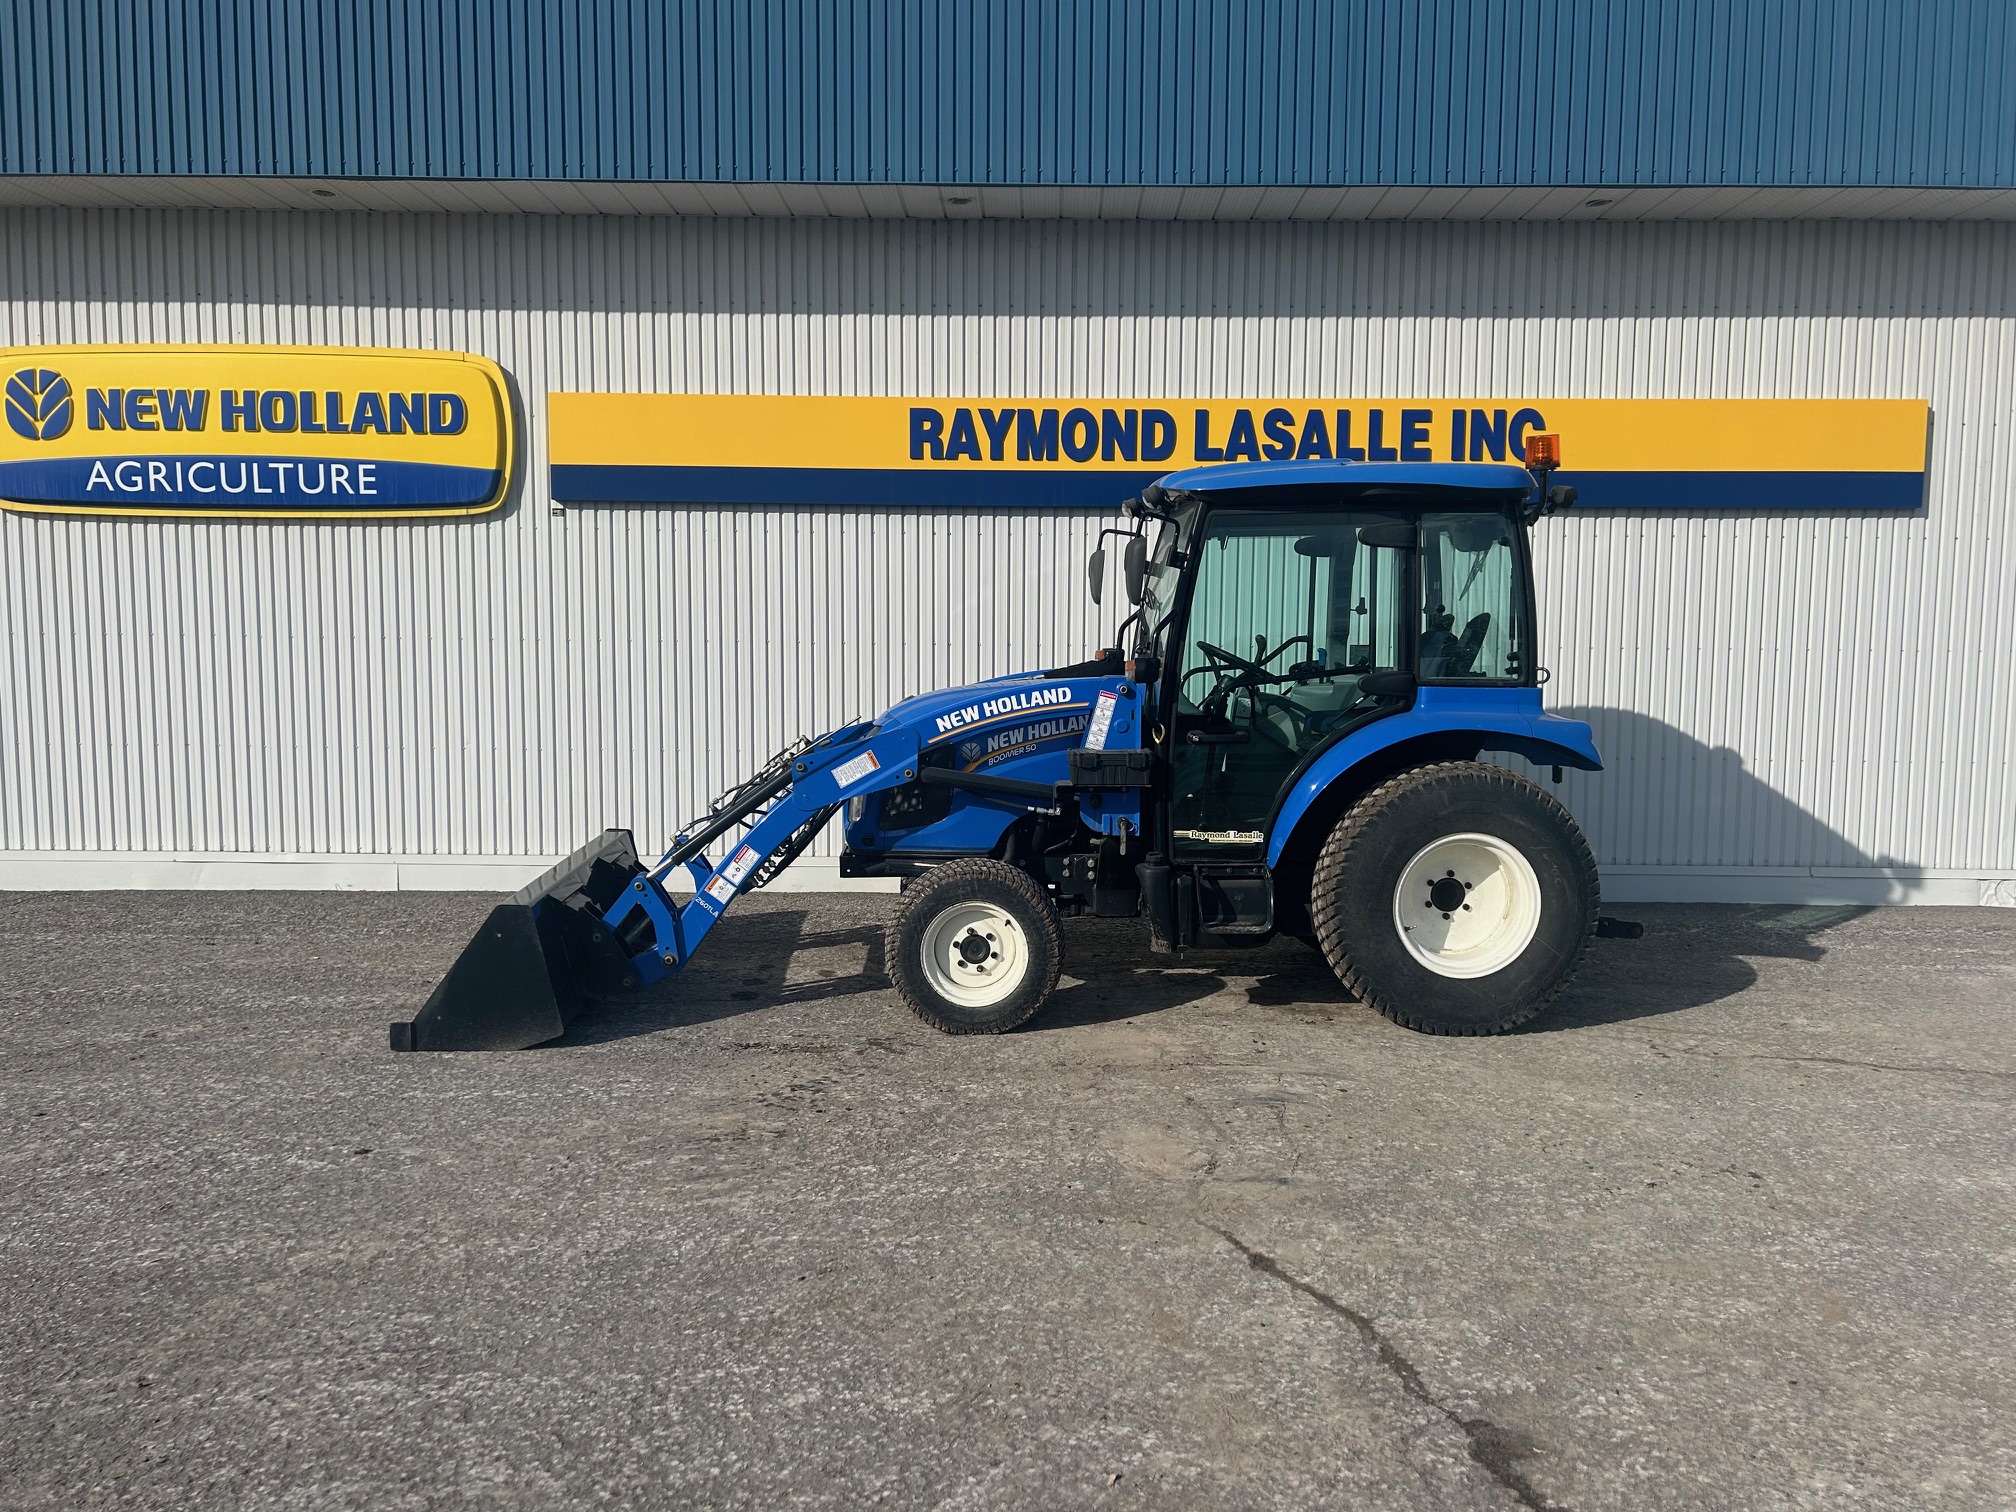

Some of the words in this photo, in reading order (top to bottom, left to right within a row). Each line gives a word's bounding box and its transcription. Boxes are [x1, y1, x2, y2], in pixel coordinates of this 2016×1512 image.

[86, 388, 209, 432] NEW
[220, 389, 468, 436] HOLLAND
[909, 408, 1177, 461] RAYMOND
[1194, 408, 1433, 461] LASALLE
[1451, 407, 1547, 462] INC
[86, 460, 378, 496] AGRICULTURE
[935, 704, 979, 733] NEW
[982, 687, 1072, 717] HOLLAND
[987, 730, 1023, 753] NEW
[1028, 715, 1089, 740] HOLLAN
[988, 747, 1025, 766] BOOMER
[1025, 743, 1037, 754] 50
[1191, 831, 1230, 840] Raymond
